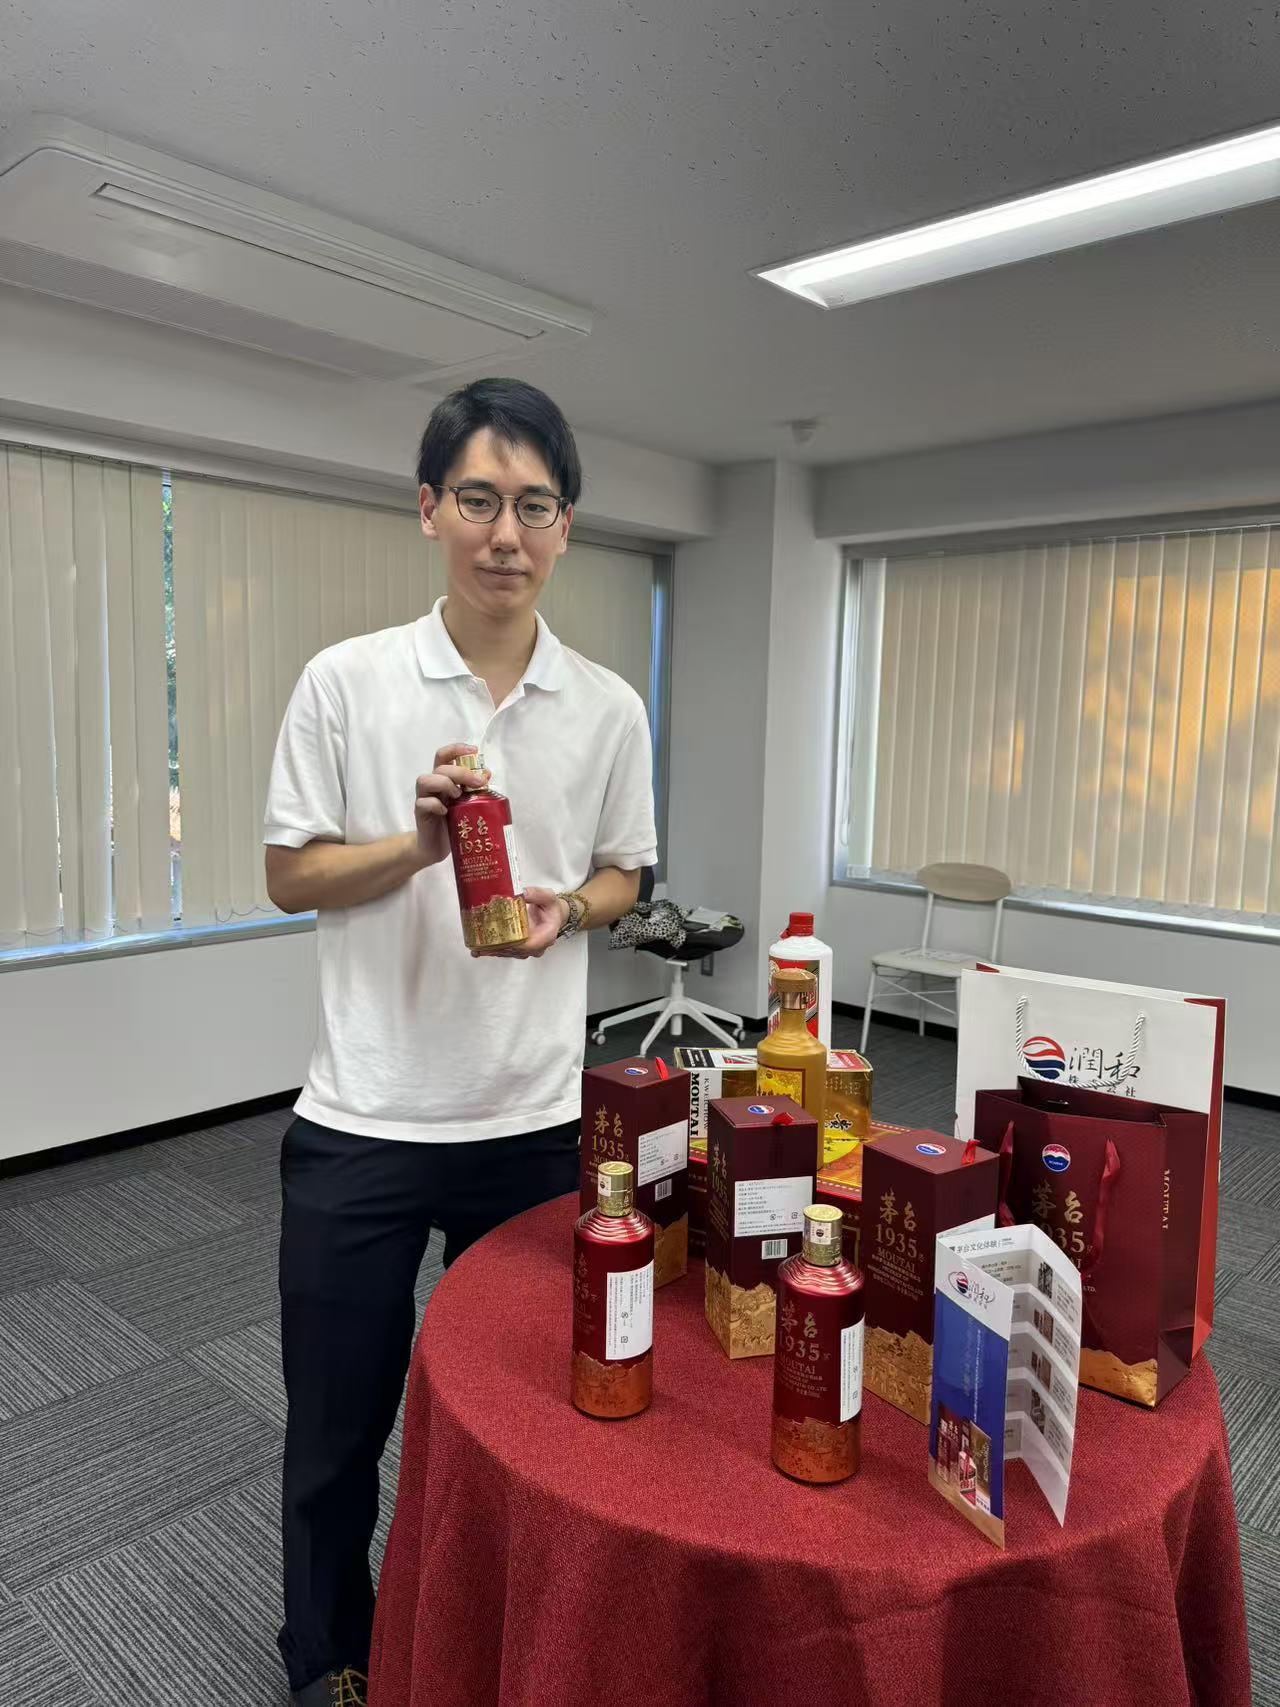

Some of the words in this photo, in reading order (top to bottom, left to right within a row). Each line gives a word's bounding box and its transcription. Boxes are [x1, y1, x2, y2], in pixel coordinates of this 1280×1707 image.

[459, 838, 494, 855] 1935
[593, 1103, 624, 1138] 茅台
[690, 1072, 700, 1136] MOUTAI
[591, 1135, 624, 1161] 1935
[879, 1187, 917, 1232] 茅台
[1031, 1178, 1084, 1224] 茅台
[875, 1223, 918, 1258] 1935
[878, 1246, 916, 1274] MOUTAI
[781, 1301, 818, 1339] 茅台
[779, 1330, 820, 1362] 1935
